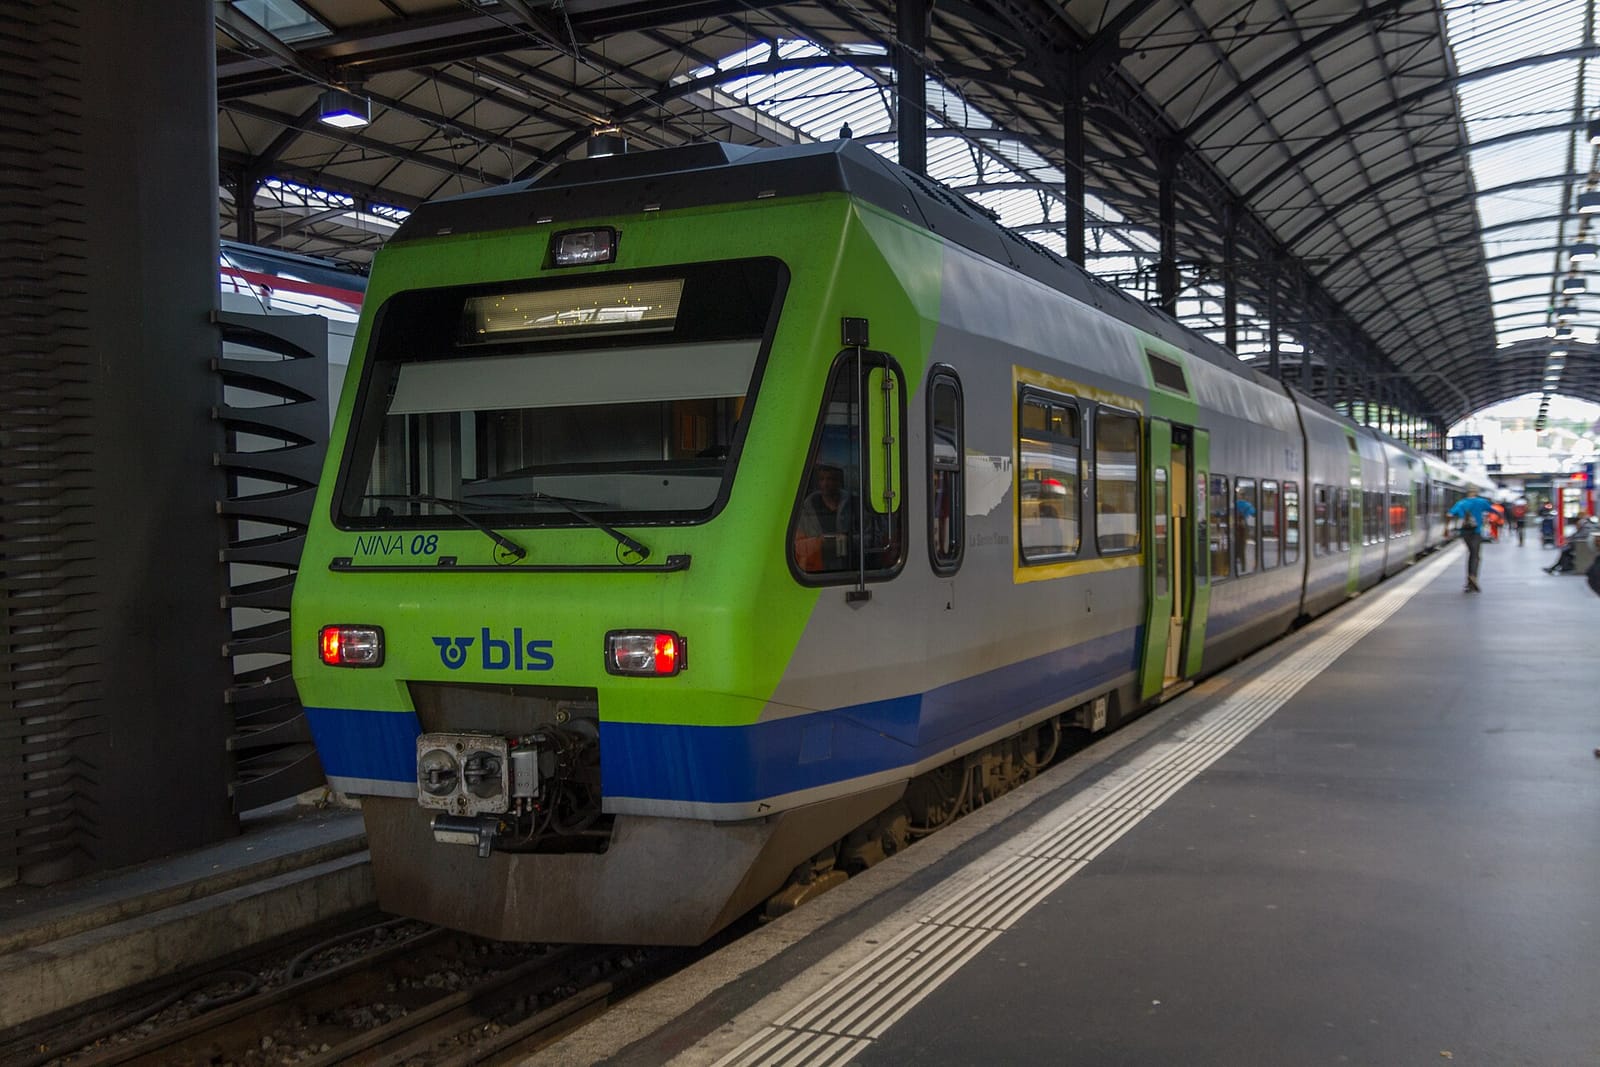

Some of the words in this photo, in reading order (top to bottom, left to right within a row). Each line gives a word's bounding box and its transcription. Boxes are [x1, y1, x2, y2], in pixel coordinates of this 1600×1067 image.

[353, 535, 404, 555] NINA
[410, 534, 439, 555] 08
[481, 627, 554, 671] bls
